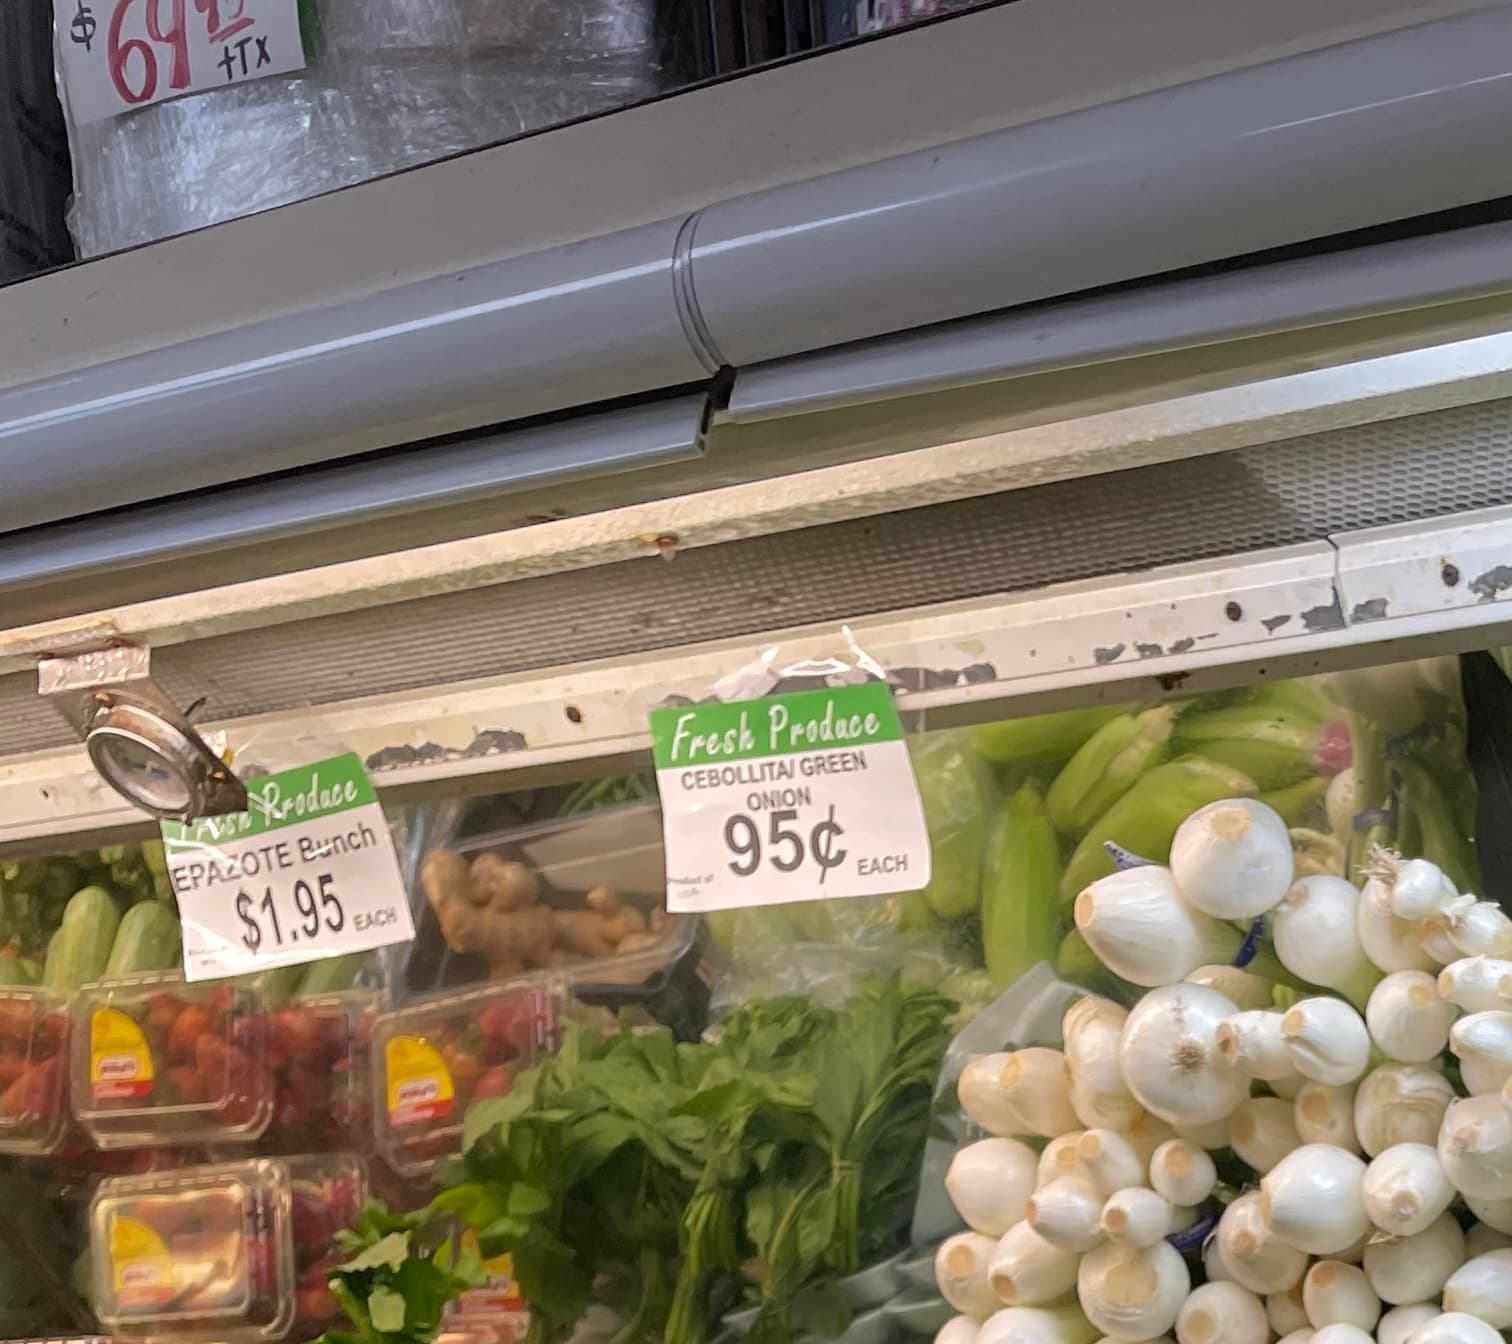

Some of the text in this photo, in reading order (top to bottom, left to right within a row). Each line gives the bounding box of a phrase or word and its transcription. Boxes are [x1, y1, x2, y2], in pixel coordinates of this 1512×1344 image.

[671, 700, 880, 762] Fresh Produce
[799, 750, 867, 777] GREEN
[262, 773, 360, 827] Produce
[746, 787, 812, 812] ONION
[173, 839, 293, 892] EPAZOTE
[723, 804, 848, 885] 95¢
[856, 853, 909, 877] EACH
[235, 873, 345, 956] $1.95
[353, 906, 398, 932] EACH
